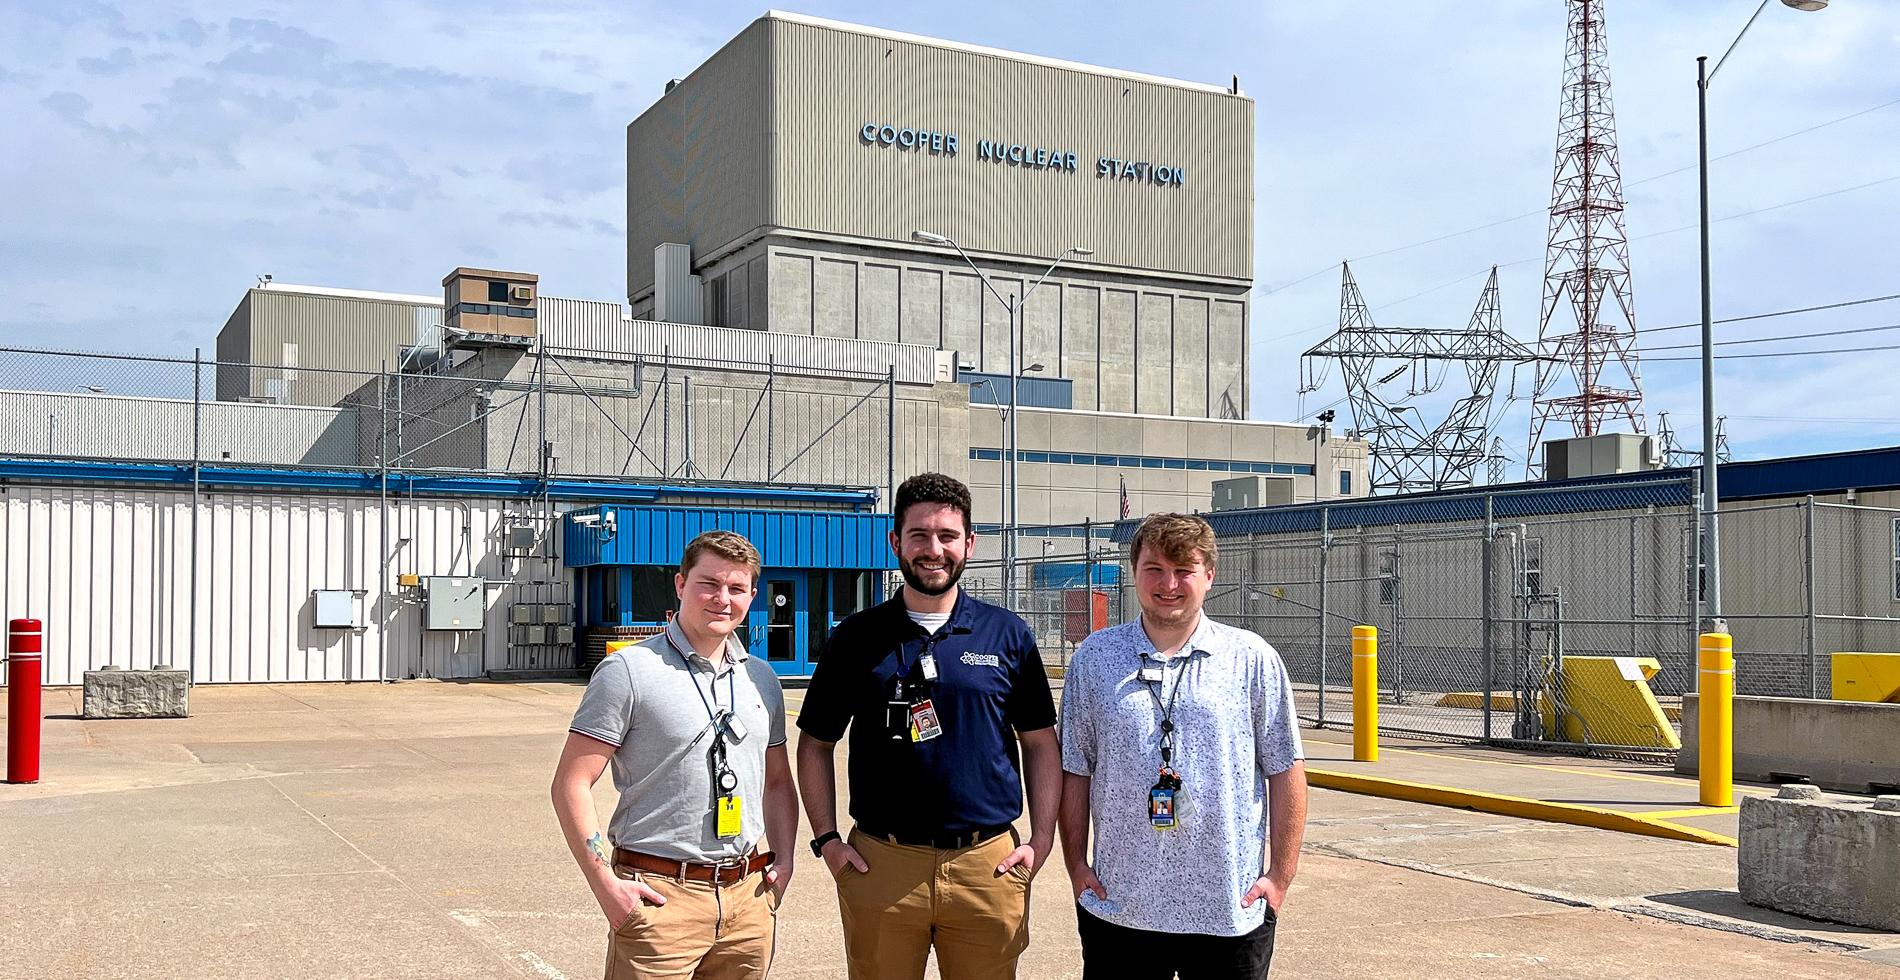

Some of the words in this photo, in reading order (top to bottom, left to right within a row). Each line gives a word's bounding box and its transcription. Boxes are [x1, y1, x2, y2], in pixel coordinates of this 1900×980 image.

[861, 122, 959, 153] COOPER
[979, 138, 1078, 170] NUCLEAR
[1098, 156, 1185, 185] STATION
